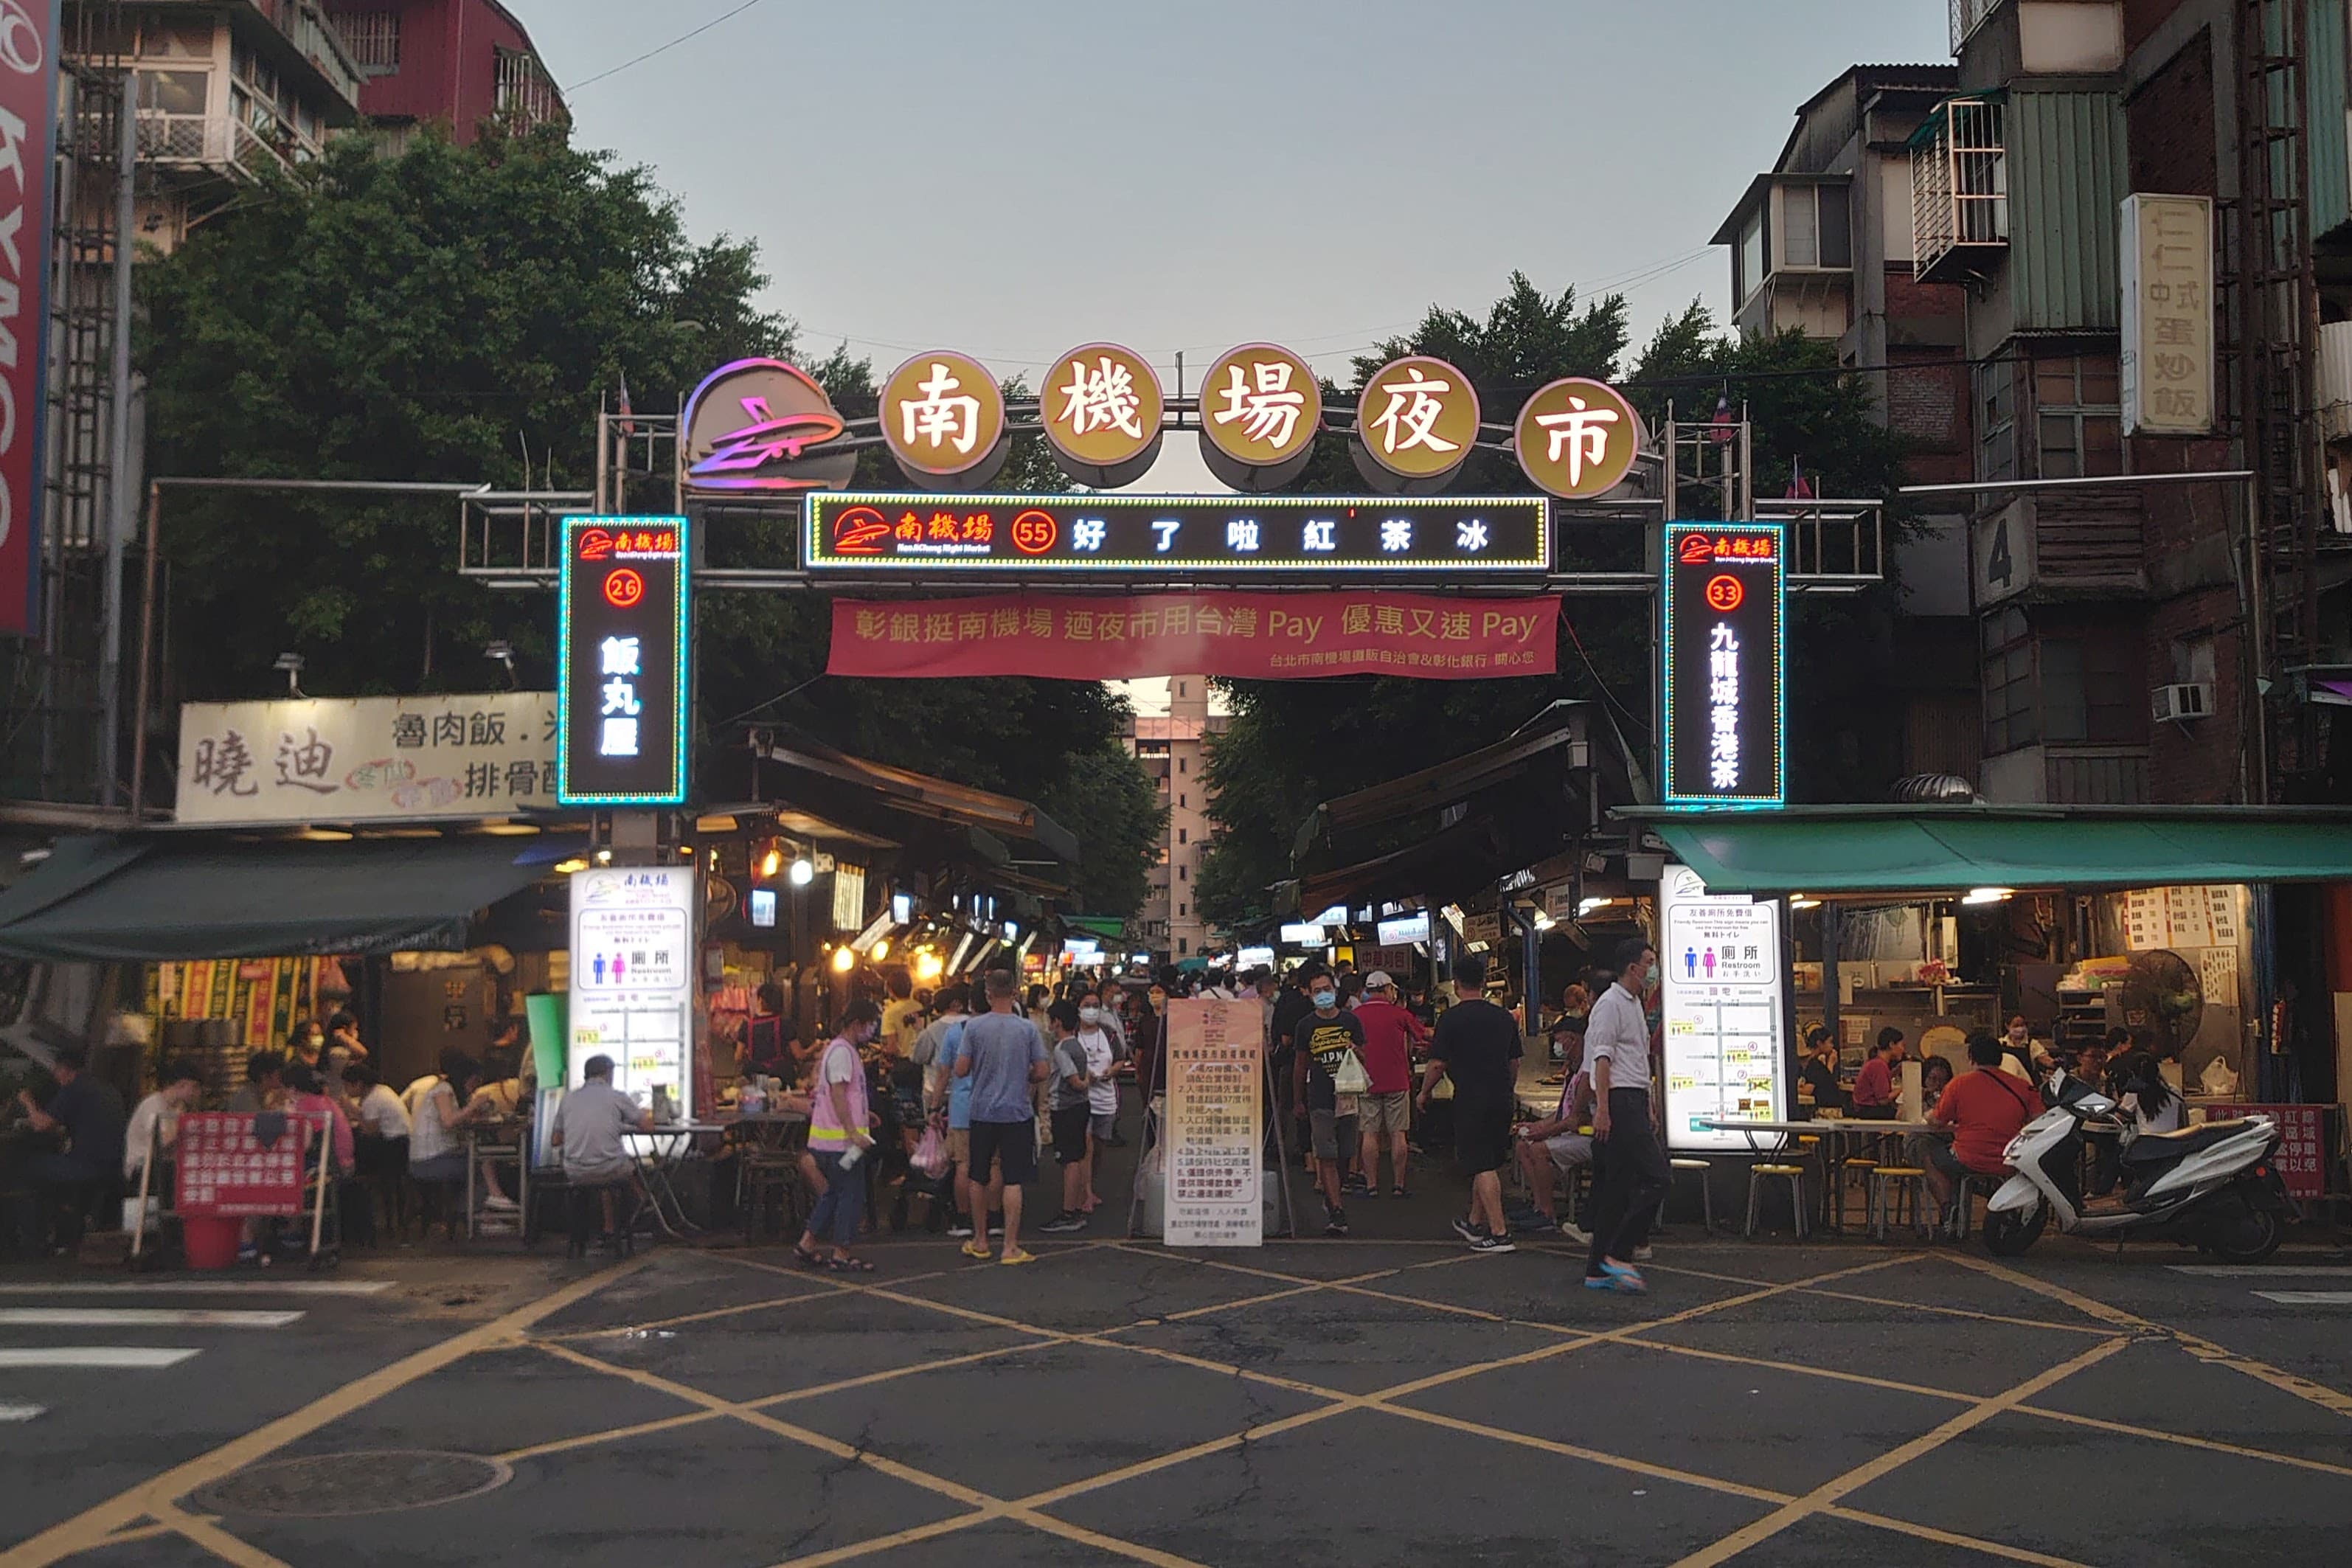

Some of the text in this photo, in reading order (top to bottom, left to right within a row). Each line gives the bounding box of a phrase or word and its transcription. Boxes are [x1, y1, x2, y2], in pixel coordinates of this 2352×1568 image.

[898, 355, 1621, 489] 南機場夜市
[614, 531, 674, 552] 南機場
[895, 511, 993, 542] 南機場
[1073, 518, 1488, 551] 好了啦紅茶冰
[1713, 537, 1772, 556] 南機場
[1987, 518, 2014, 589] 4
[856, 606, 1053, 644] 彰銀挺南機場
[1269, 610, 1323, 643] Pay
[1341, 603, 1472, 641] 優惠又速
[1482, 611, 1538, 643] Pay
[392, 710, 506, 749] 魯肉飯
[193, 726, 341, 797] 曉迪
[1721, 945, 1758, 960] 廁所
[1721, 961, 1761, 969] Restroom
